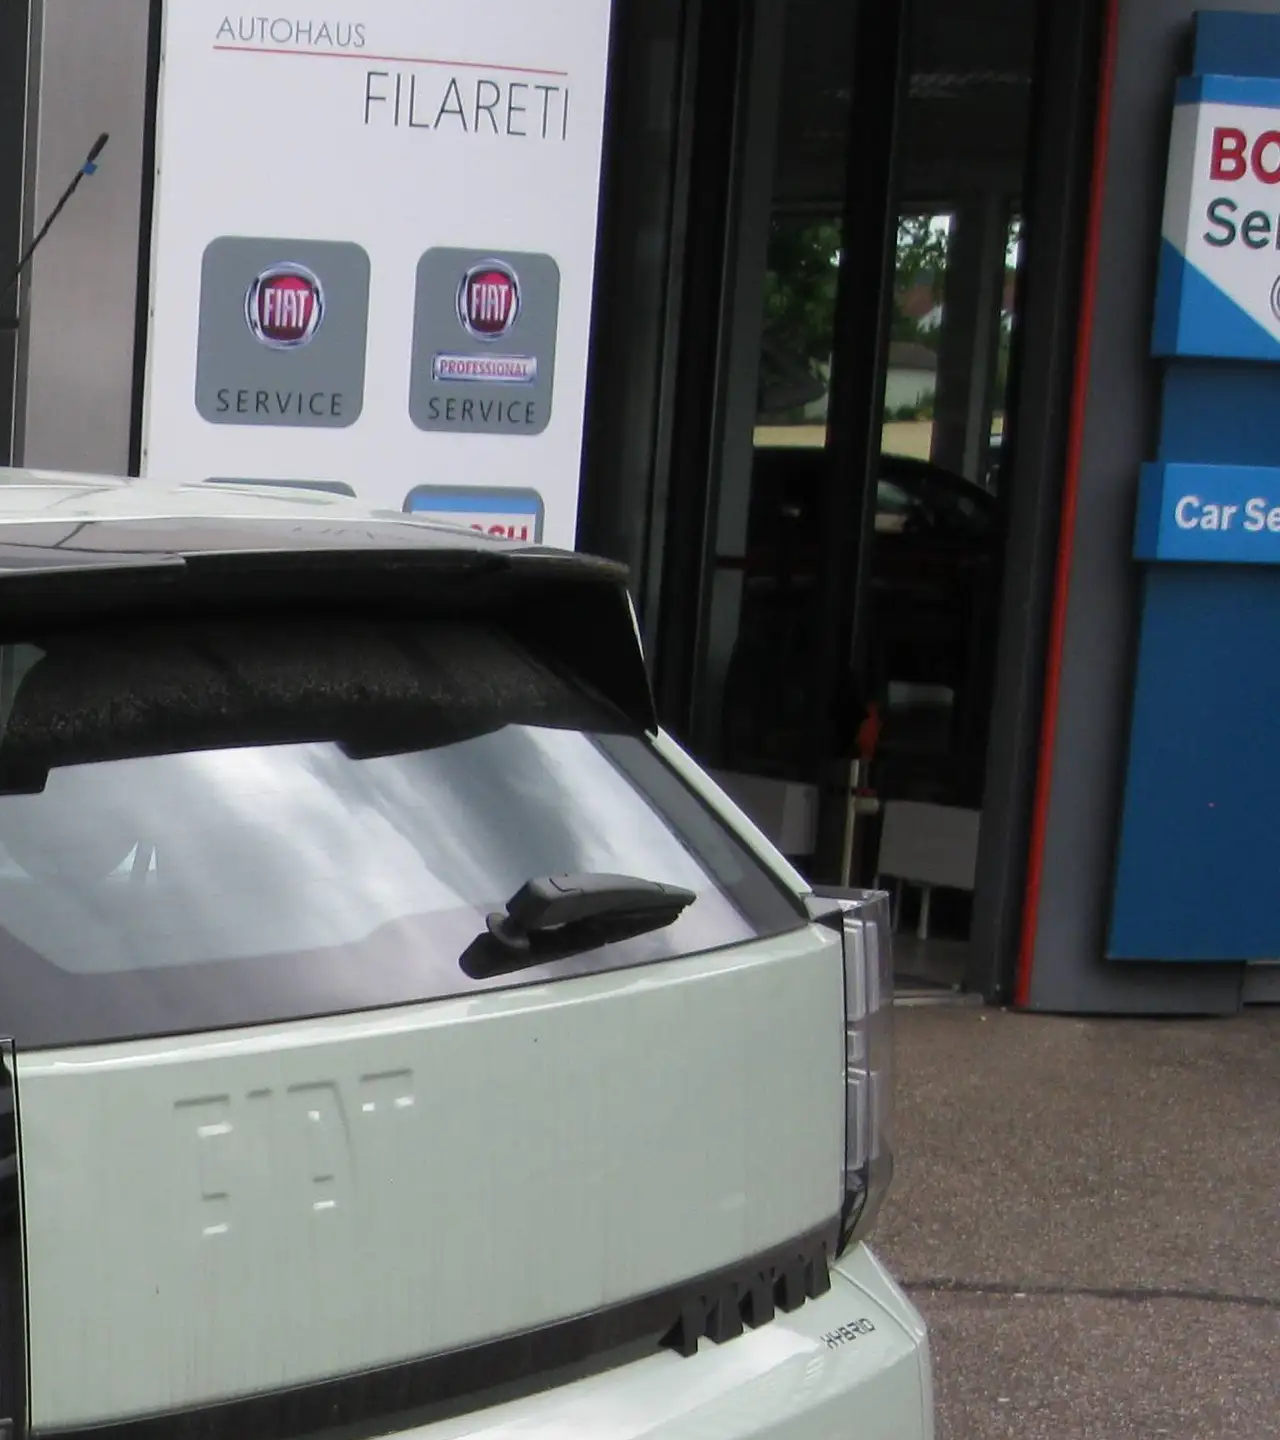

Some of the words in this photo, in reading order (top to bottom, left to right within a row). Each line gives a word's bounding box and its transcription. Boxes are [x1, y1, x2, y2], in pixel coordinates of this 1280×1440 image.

[215, 16, 367, 48] AUTOHAUS
[363, 71, 570, 141] FILARETI
[1209, 126, 1280, 184] BO
[1203, 196, 1280, 250] Se
[263, 287, 309, 328] FIAT
[471, 283, 509, 321] FIAT
[440, 359, 528, 377] PROFESSIONAL
[215, 389, 344, 416] SERVICE
[427, 396, 536, 424] SERVICE
[1174, 494, 1238, 531] Car
[1242, 496, 1280, 533] Se
